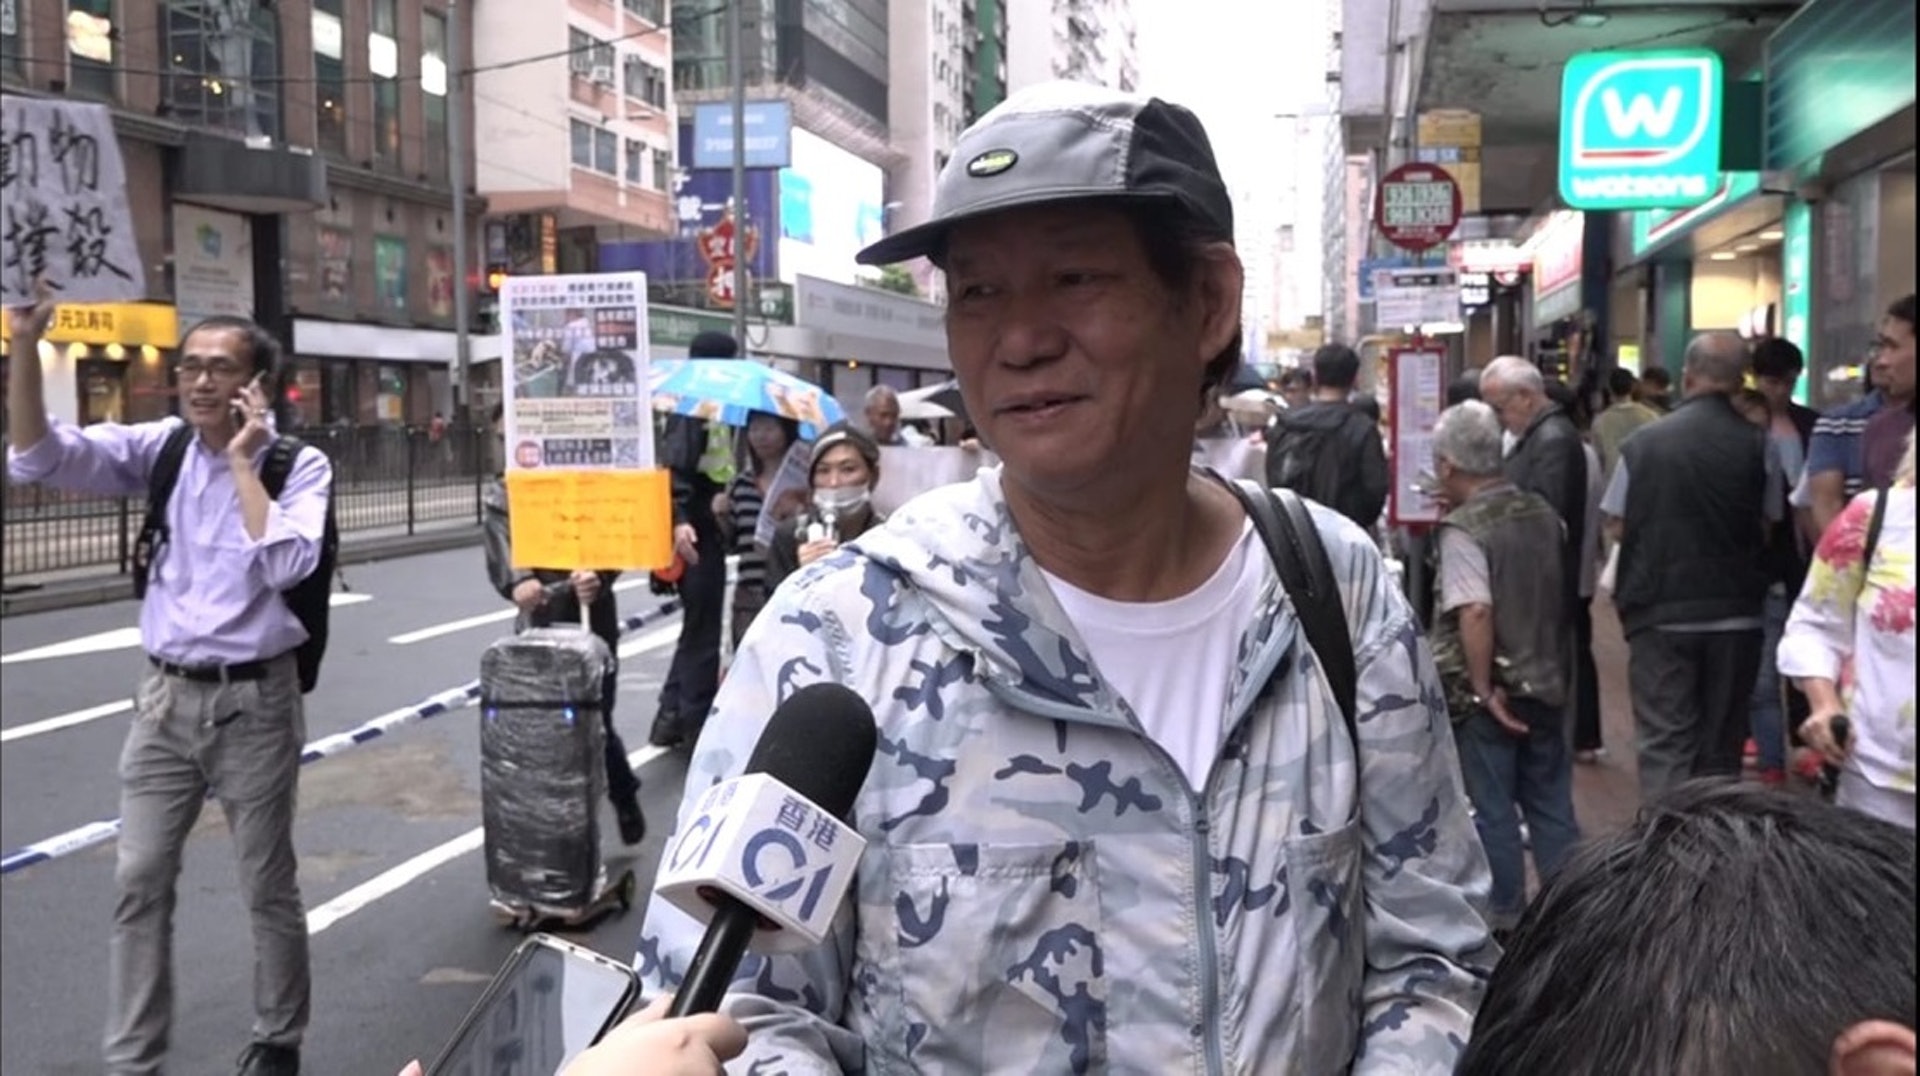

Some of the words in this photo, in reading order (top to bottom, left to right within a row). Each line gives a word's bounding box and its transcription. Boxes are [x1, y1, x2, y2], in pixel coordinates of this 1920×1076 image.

[1602, 85, 1682, 137] W
[1572, 176, 1706, 198] watsons
[775, 795, 838, 852] 香港
